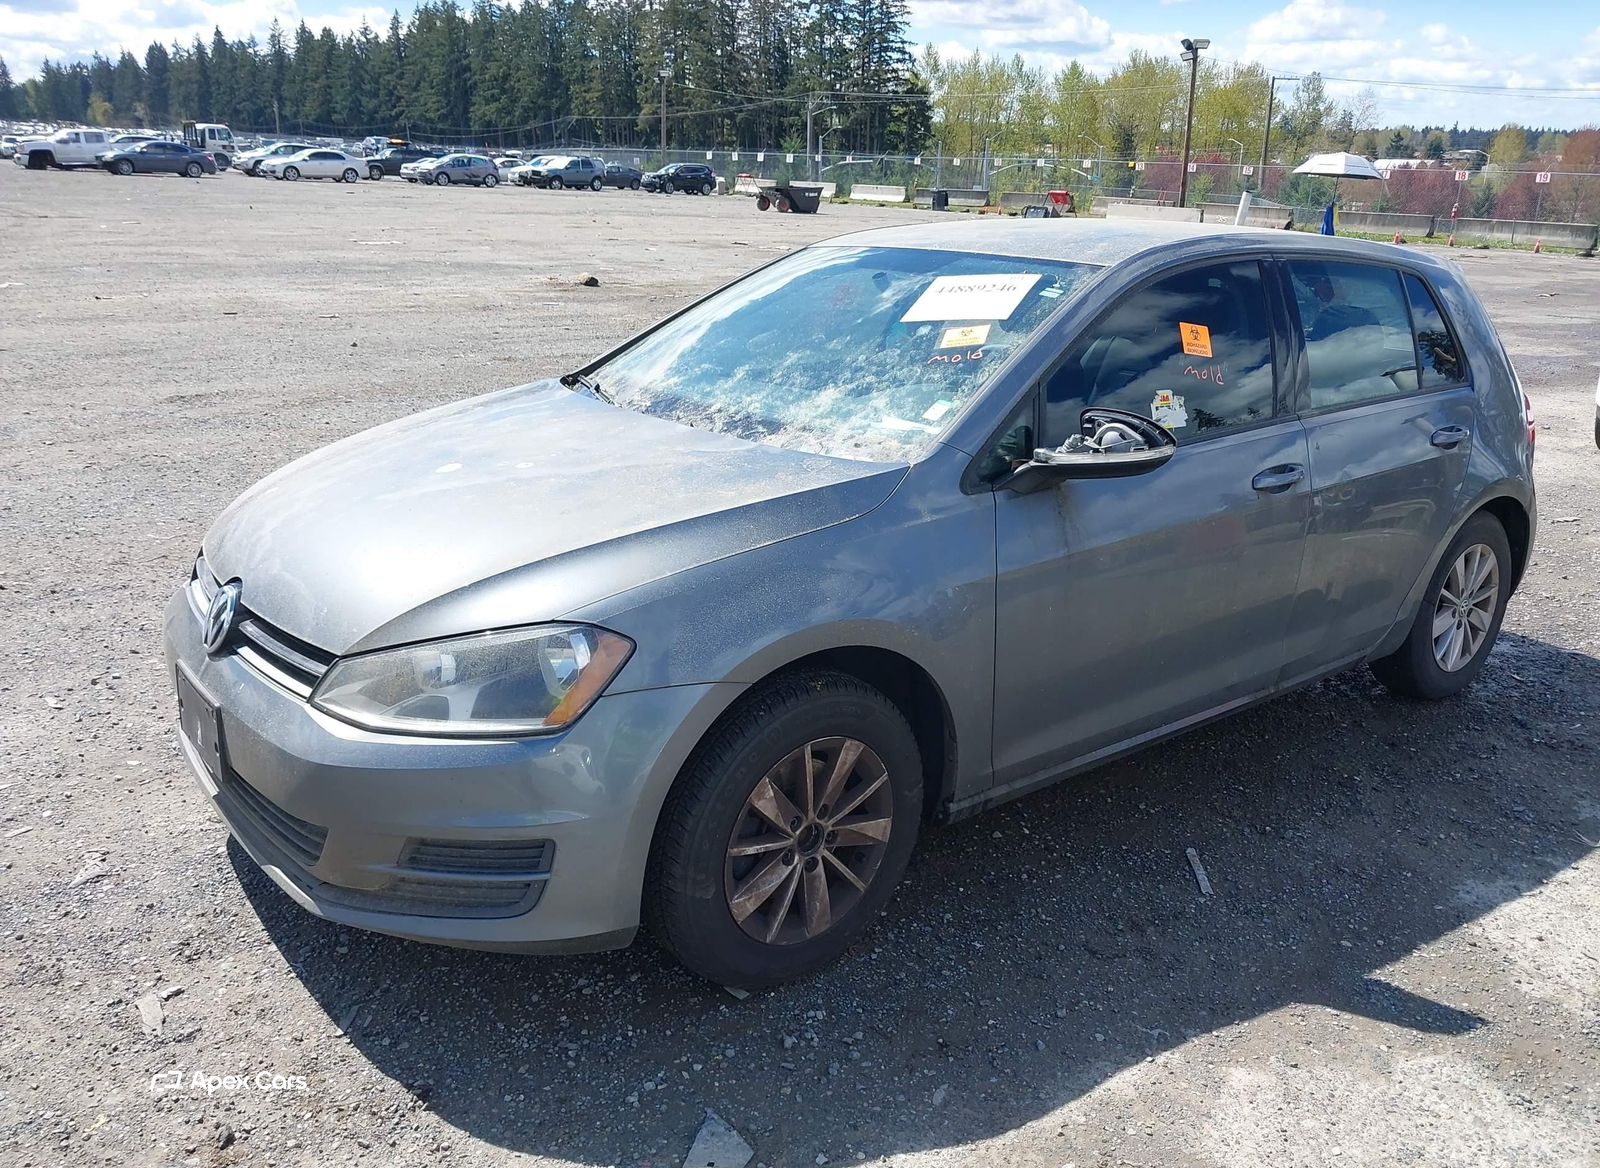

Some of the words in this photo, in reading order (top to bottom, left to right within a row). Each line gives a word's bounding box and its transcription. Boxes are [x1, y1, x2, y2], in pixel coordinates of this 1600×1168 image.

[1457, 172, 1466, 180] 18
[1538, 174, 1548, 182] 19
[934, 284, 1017, 294] 44889246
